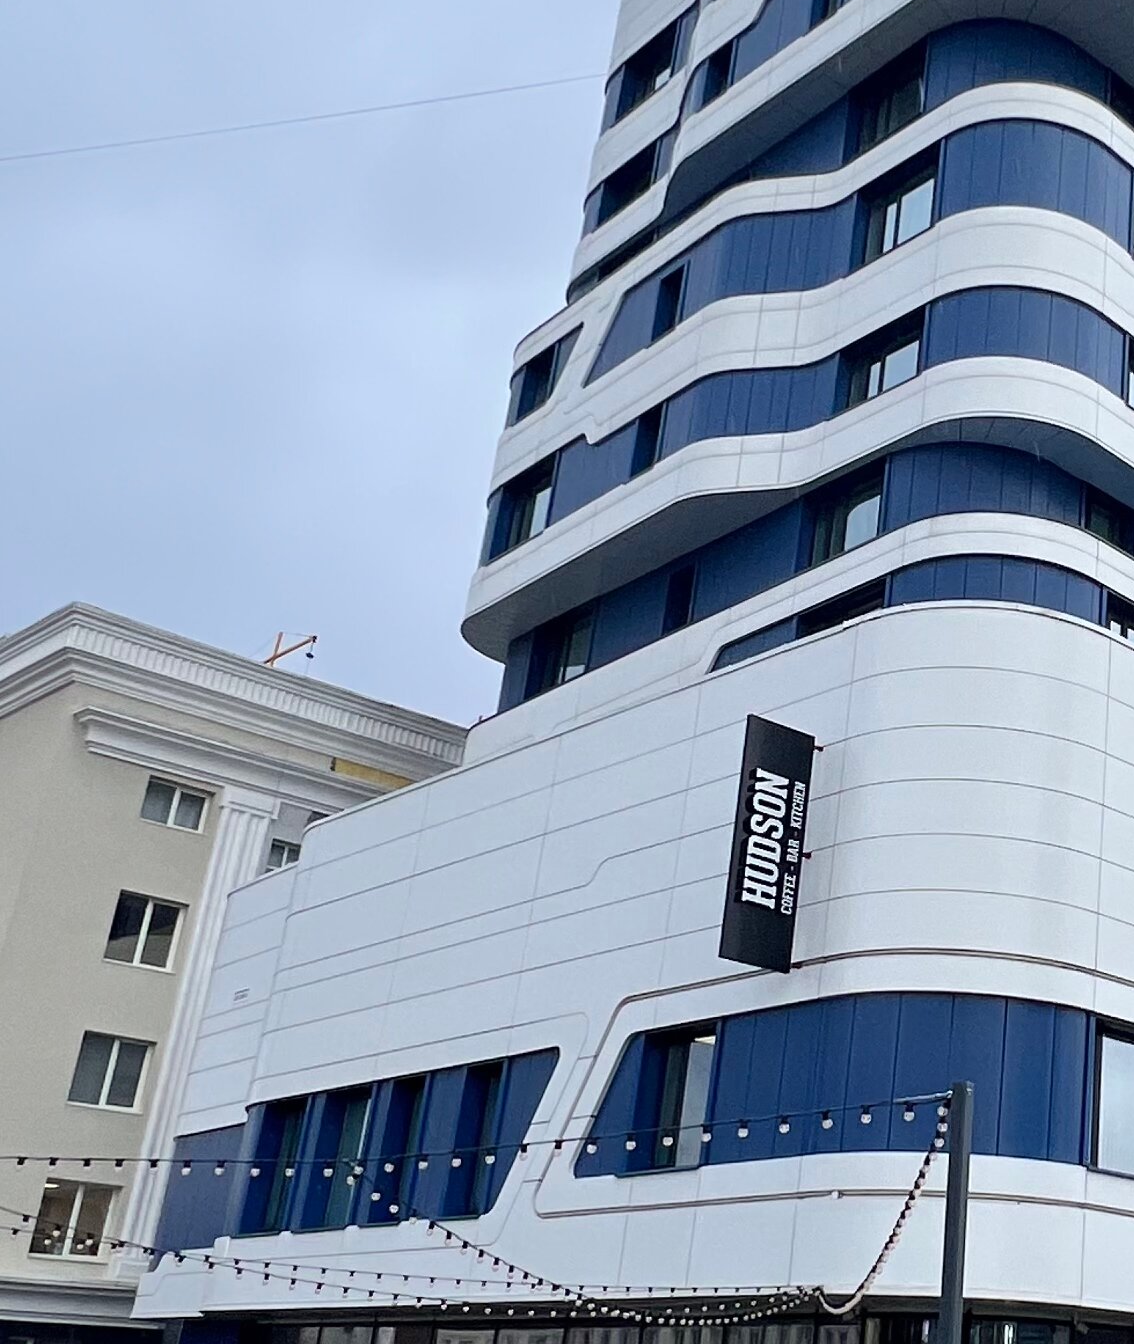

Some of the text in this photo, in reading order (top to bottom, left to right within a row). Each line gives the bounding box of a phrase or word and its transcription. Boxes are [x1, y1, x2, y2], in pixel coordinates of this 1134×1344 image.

[741, 767, 790, 910] HUDSON
[780, 781, 806, 916] COFFEE BAR KITCHEN
